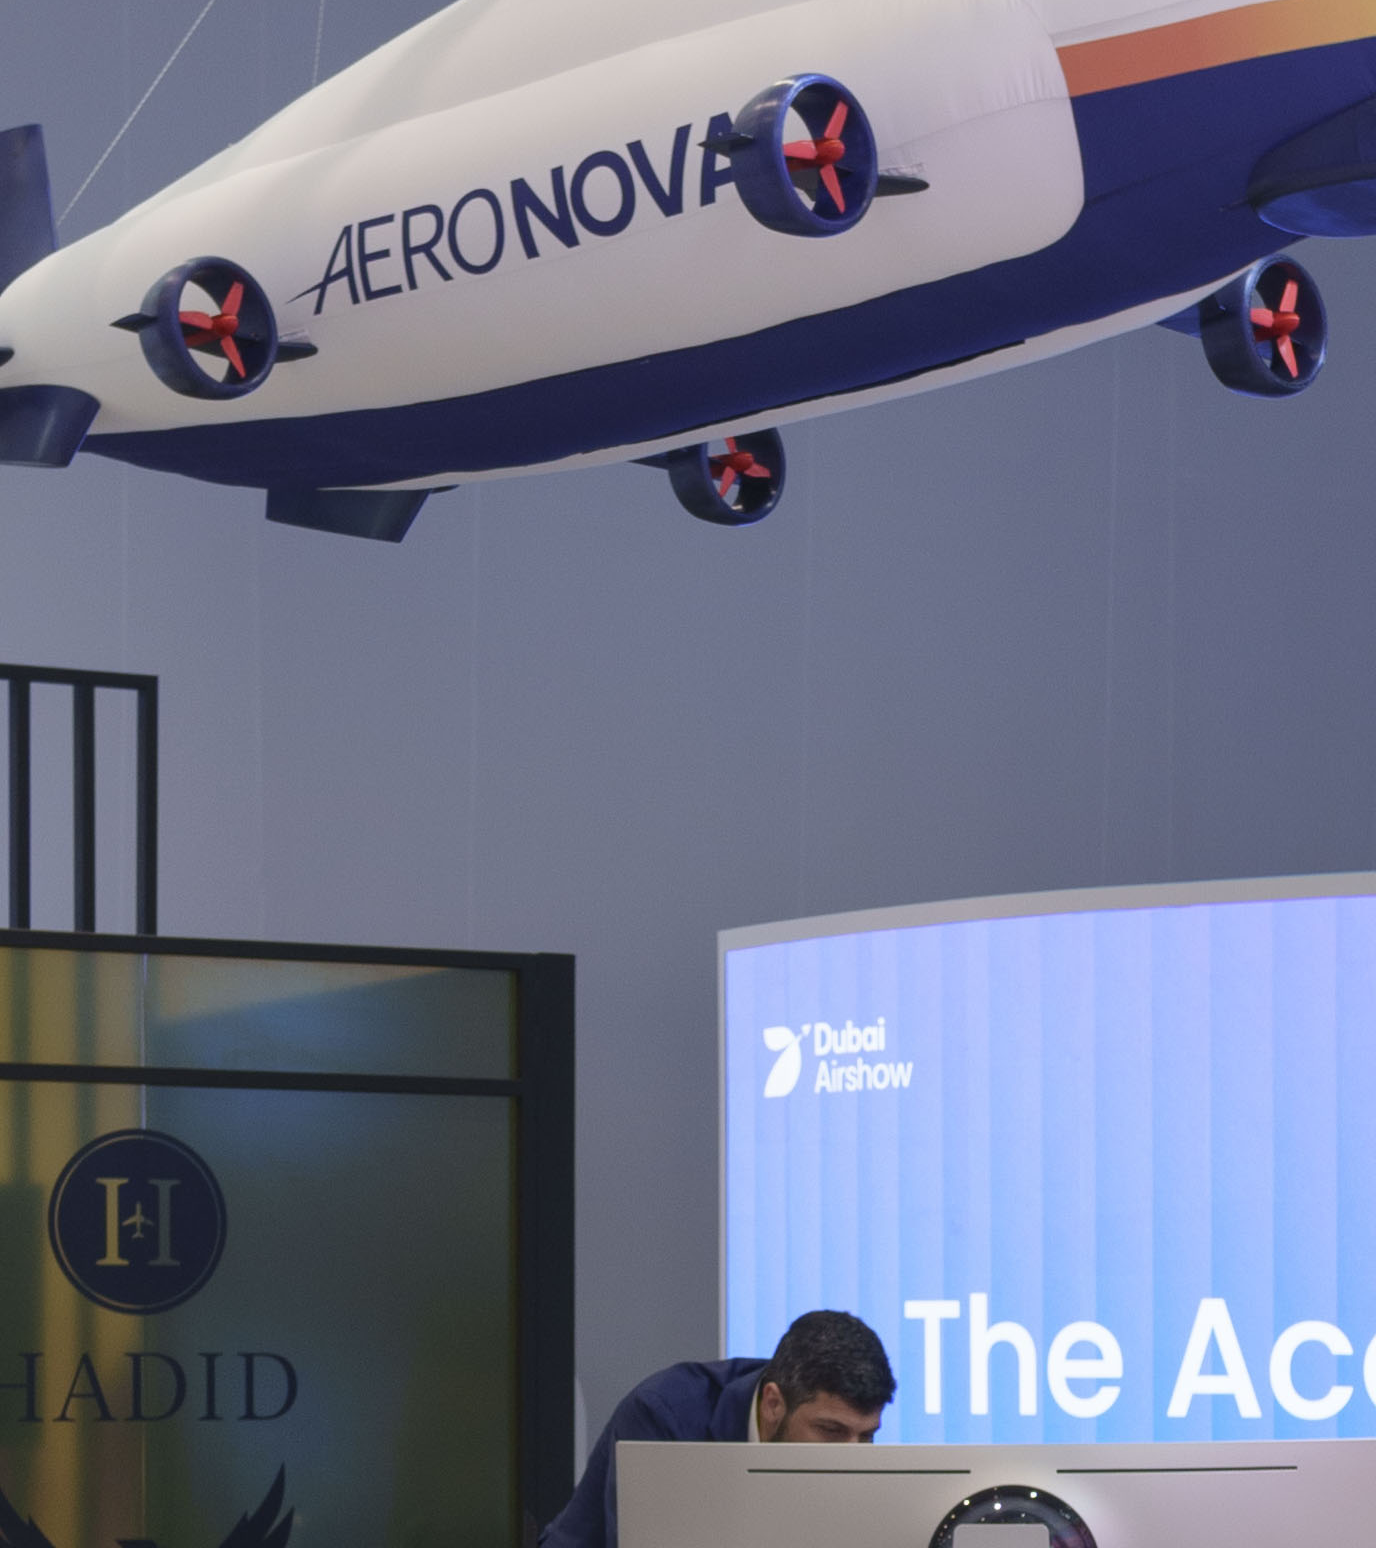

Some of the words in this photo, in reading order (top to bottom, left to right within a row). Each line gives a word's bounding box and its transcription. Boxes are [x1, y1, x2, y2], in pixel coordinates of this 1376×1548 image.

[286, 111, 736, 316] AERONOVA
[814, 1016, 886, 1056] Dubai
[814, 1057, 914, 1094] Airshow
[904, 1292, 1124, 1419] The
